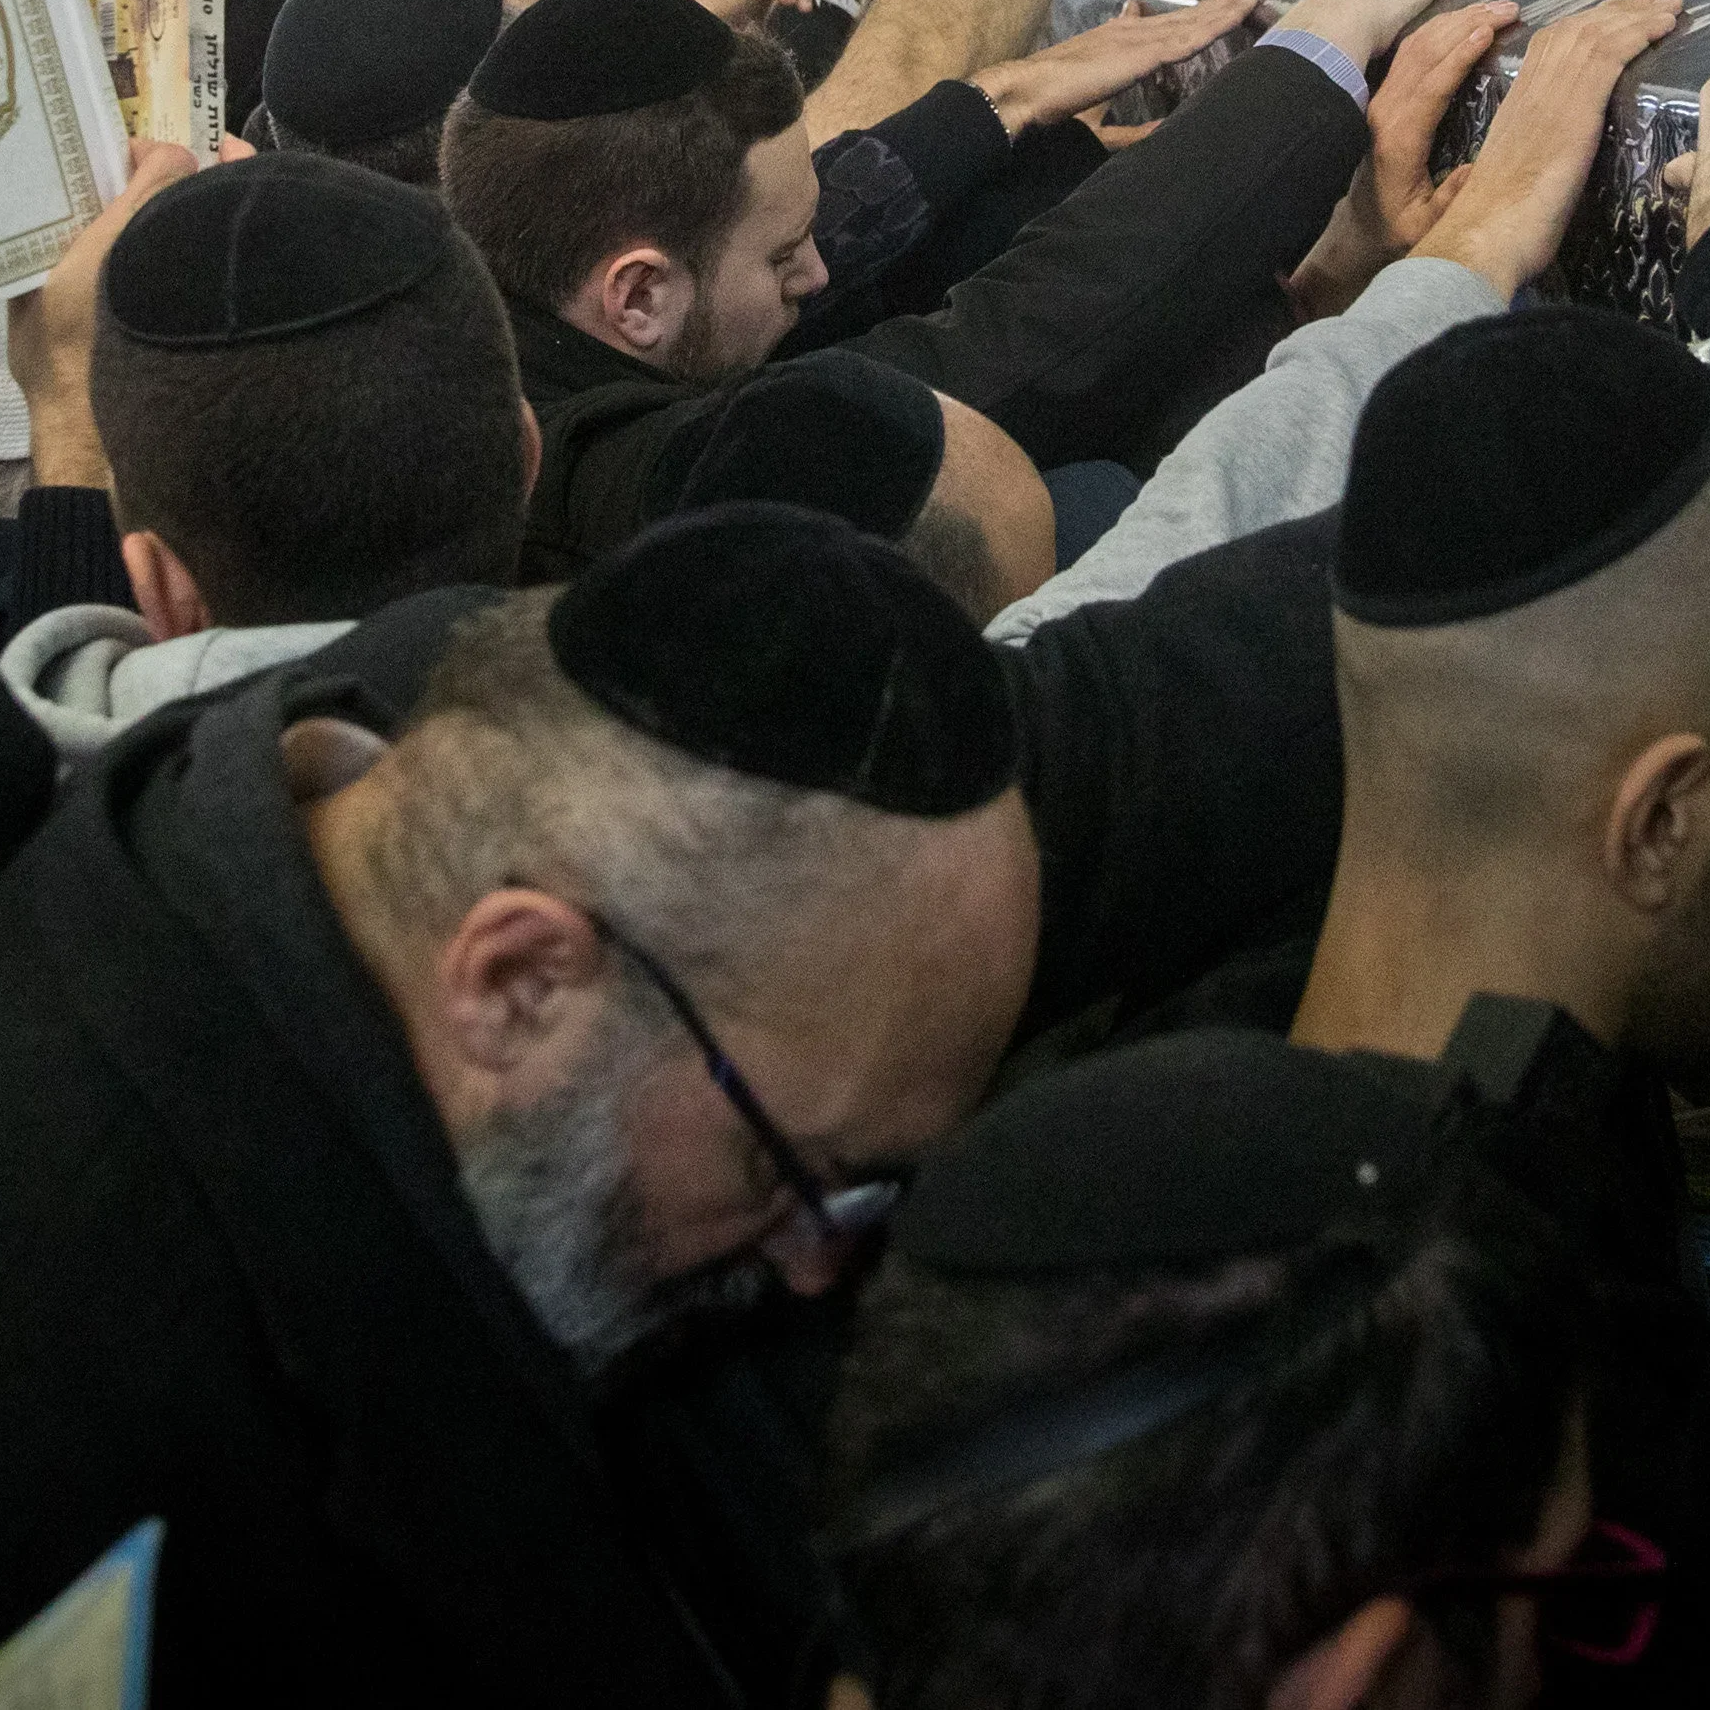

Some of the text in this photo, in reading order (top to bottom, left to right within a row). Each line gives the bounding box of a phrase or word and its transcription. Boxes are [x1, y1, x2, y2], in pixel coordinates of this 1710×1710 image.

[193, 74, 202, 109] כשר
[205, 34, 220, 153] נרות שולחן
